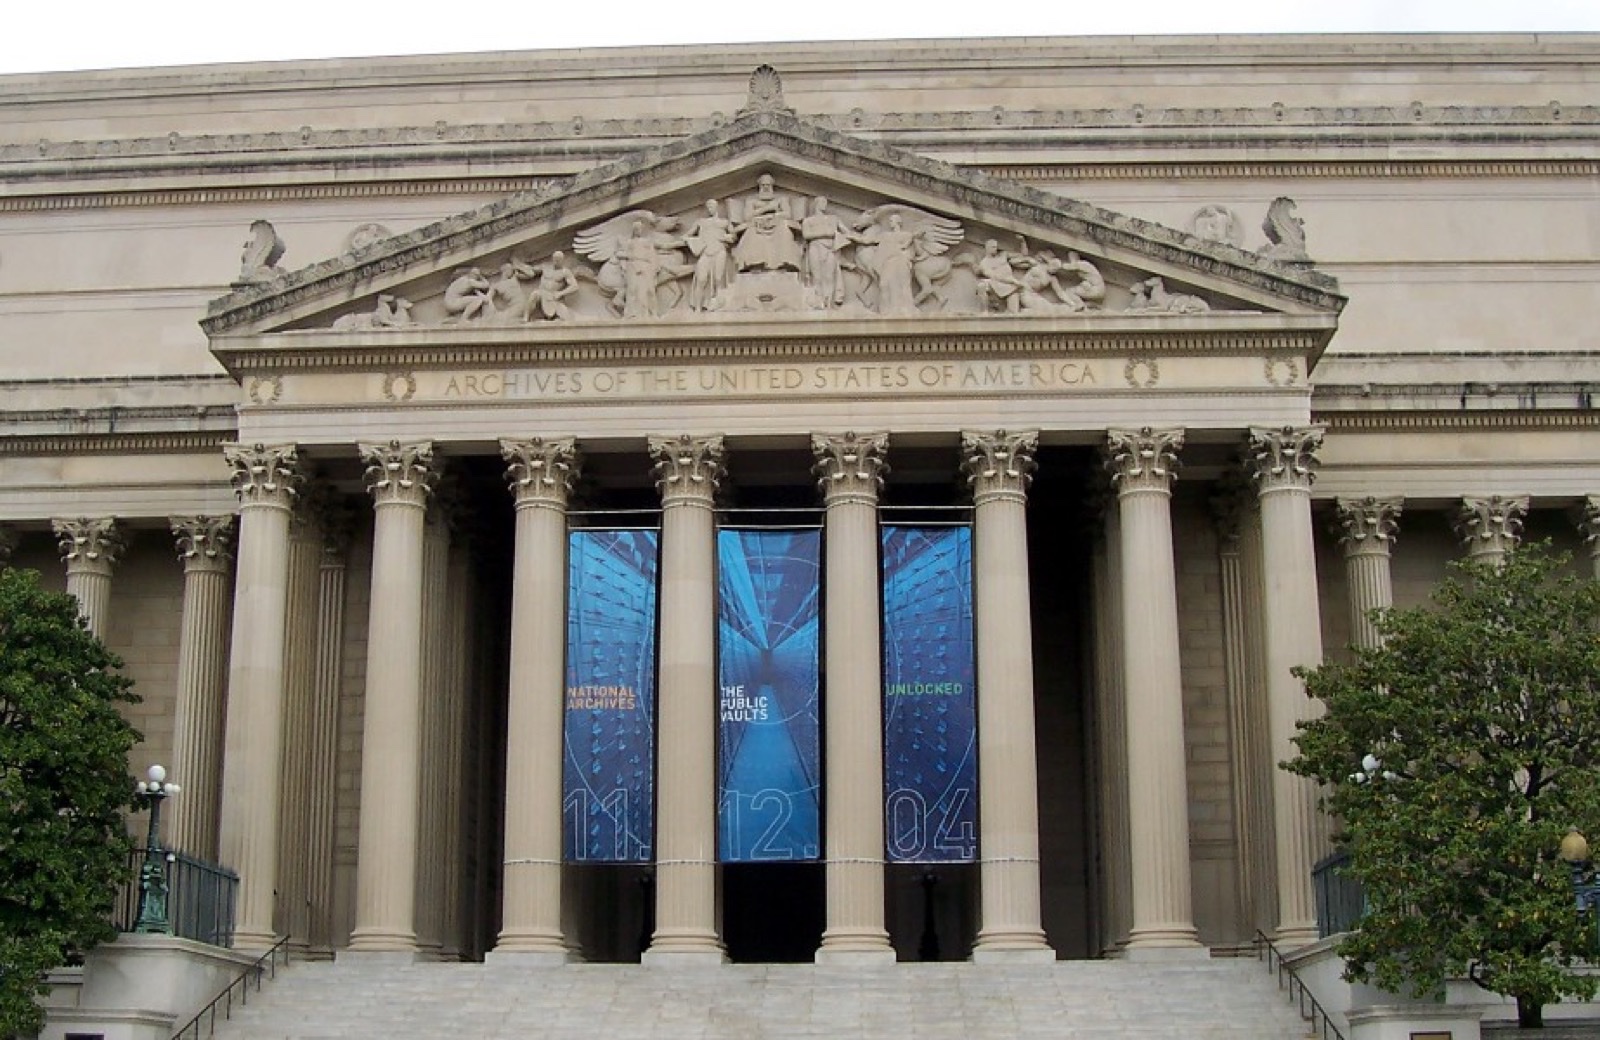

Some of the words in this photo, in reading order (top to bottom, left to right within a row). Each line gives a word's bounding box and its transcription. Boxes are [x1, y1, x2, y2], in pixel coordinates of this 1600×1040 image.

[445, 372, 583, 396] ARCHIVES
[592, 372, 628, 393] OF
[636, 371, 687, 391] THE
[700, 368, 803, 390] UNITED
[814, 366, 909, 389] STATES
[918, 365, 953, 386] OF
[961, 363, 1097, 386] AMERICA
[567, 686, 636, 699] NATIONAL
[720, 685, 745, 698] THE
[887, 683, 963, 696] UNLOCKED
[567, 698, 635, 710] ARCHIVES
[720, 697, 768, 710] PUBLIC
[720, 709, 768, 722] VAULTS
[887, 788, 977, 860] 04
